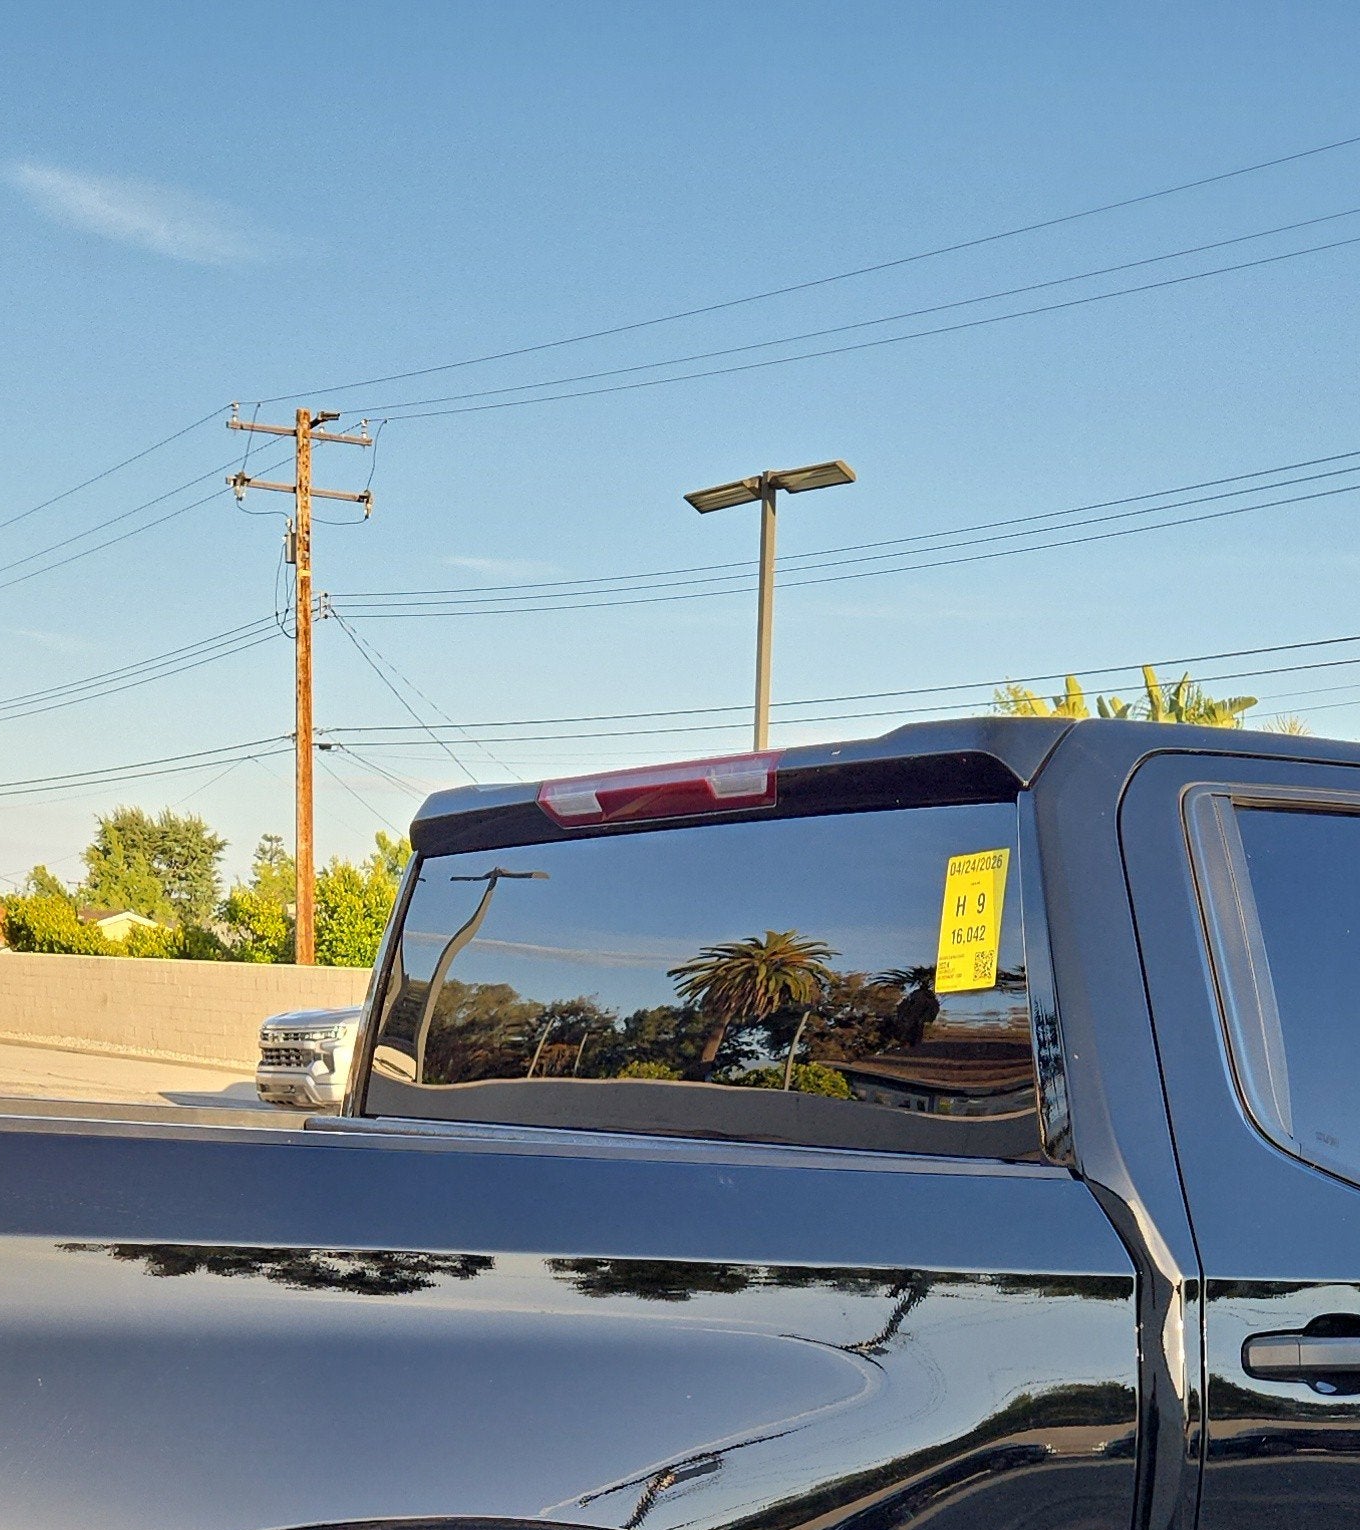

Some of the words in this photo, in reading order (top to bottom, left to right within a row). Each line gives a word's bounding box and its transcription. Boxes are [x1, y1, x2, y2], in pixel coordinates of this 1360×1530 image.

[949, 854, 1003, 876] 04/24/2026
[956, 895, 967, 918] H
[976, 892, 987, 915] 9
